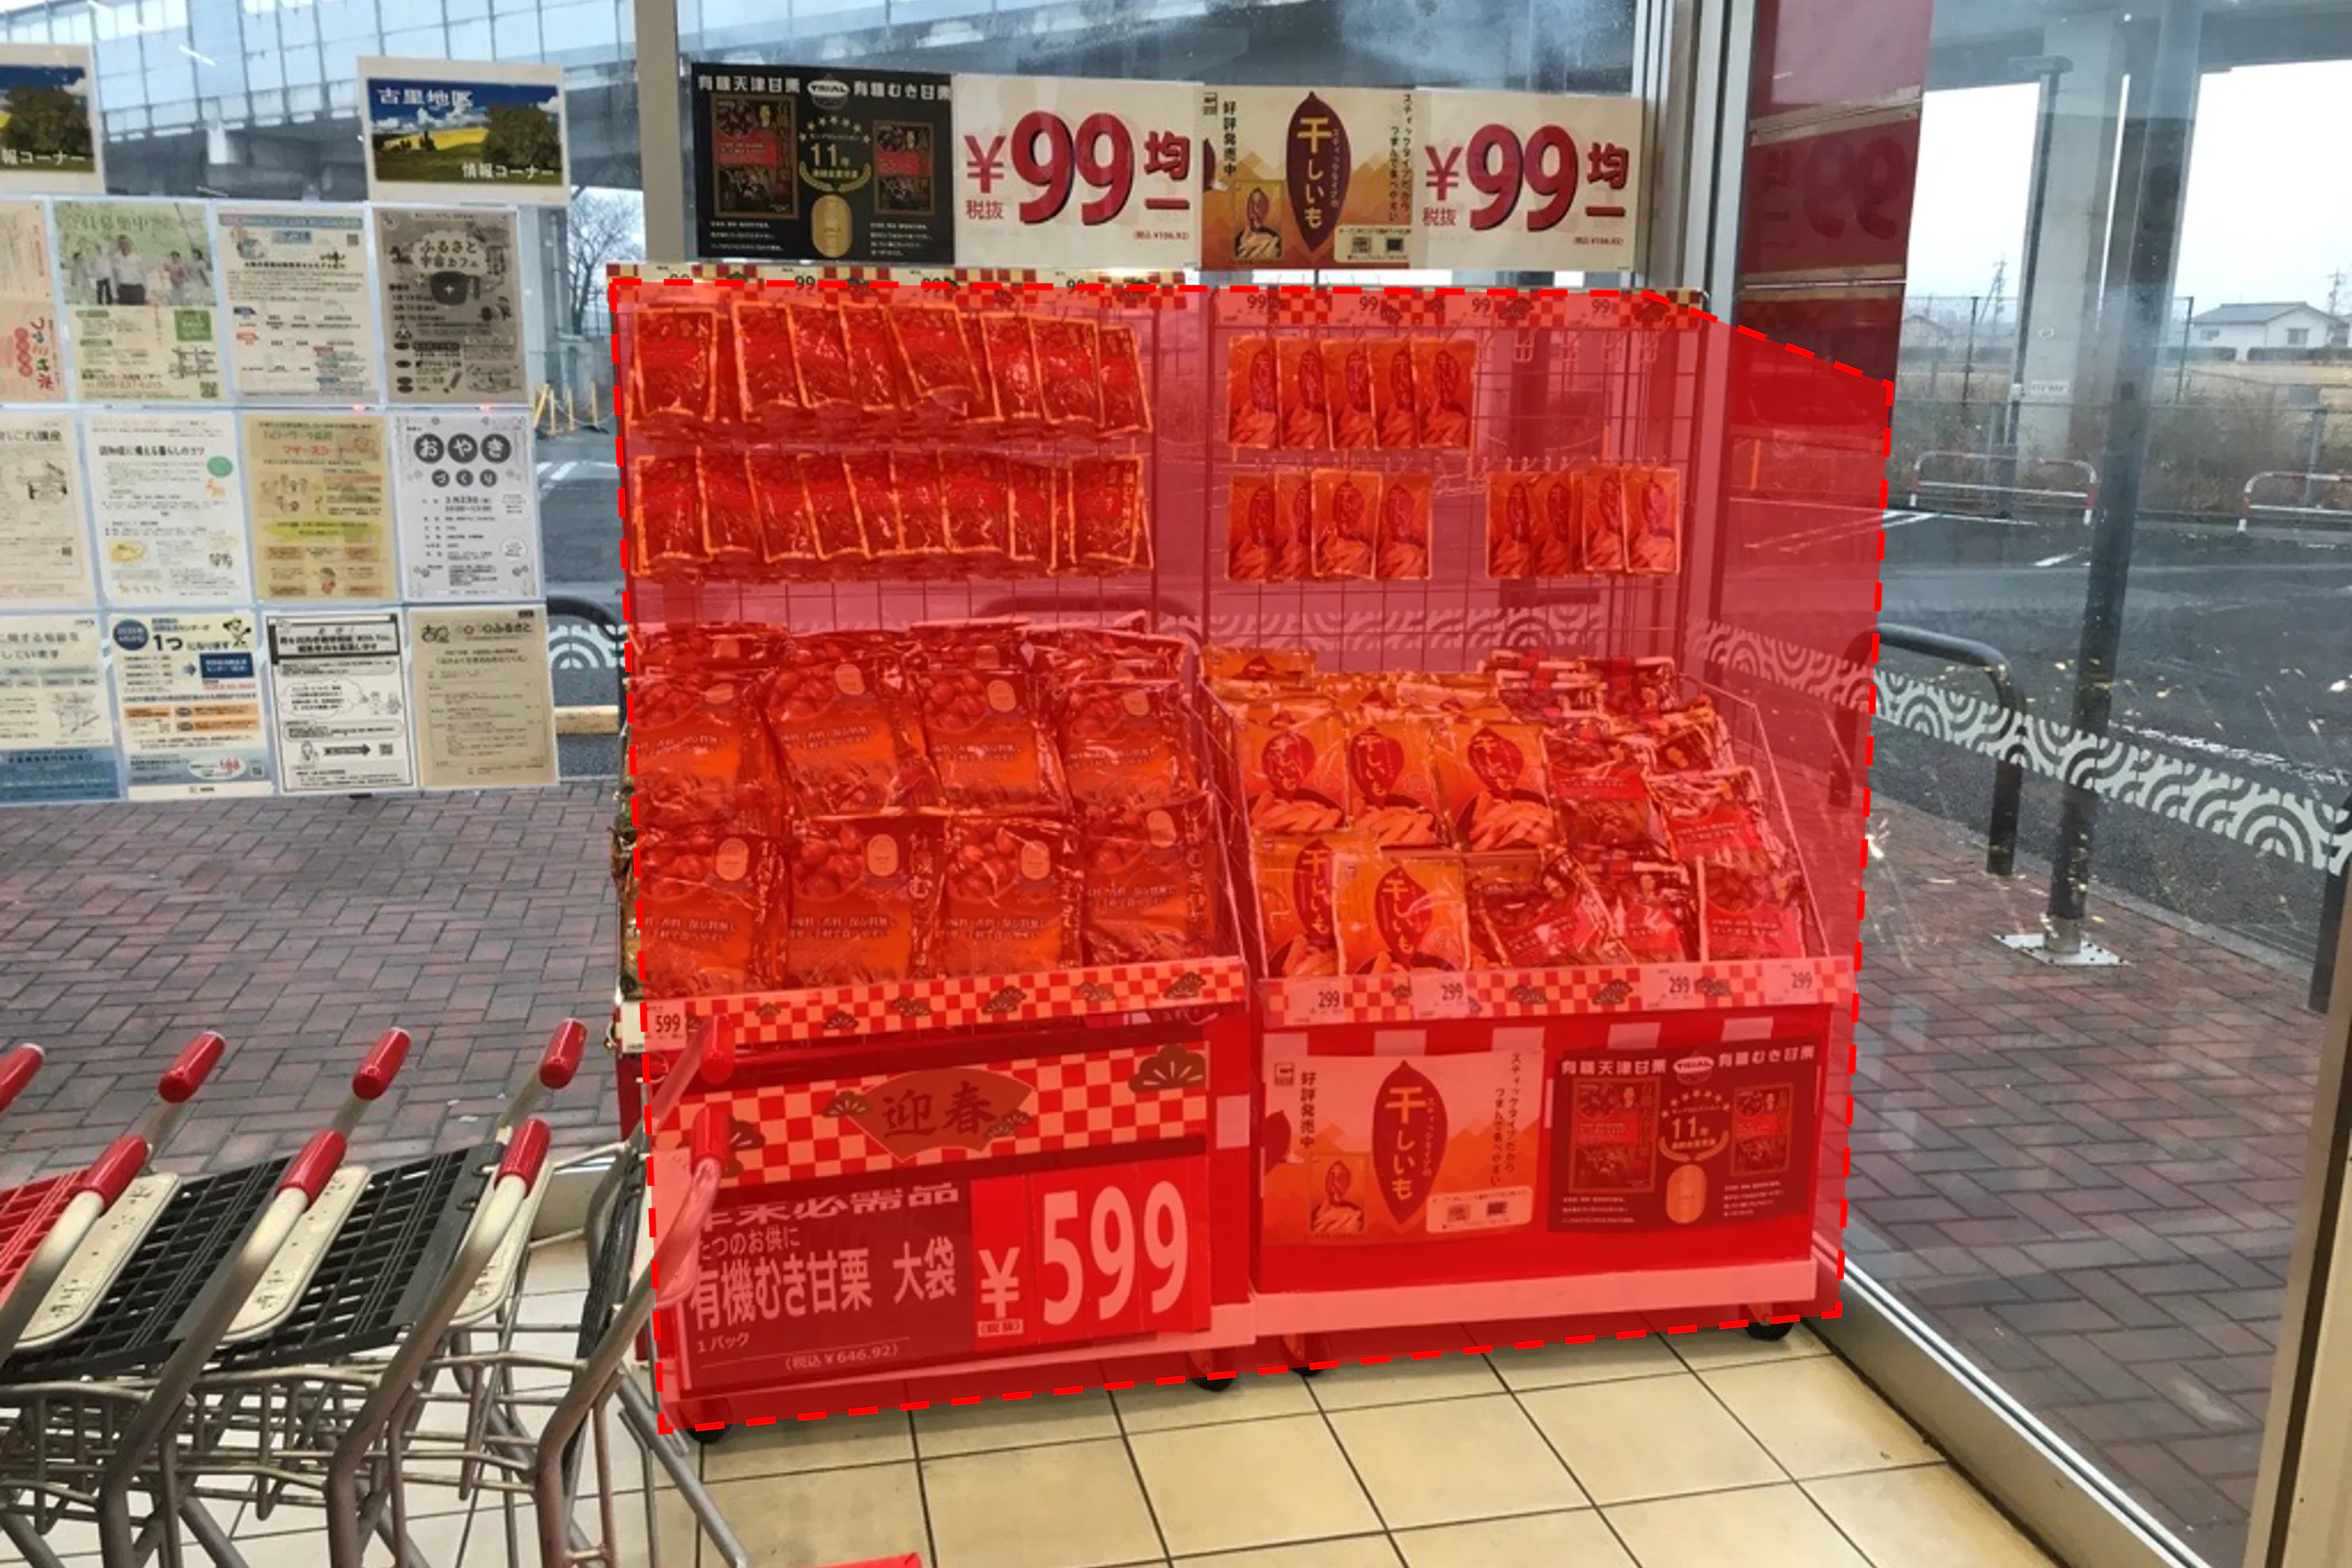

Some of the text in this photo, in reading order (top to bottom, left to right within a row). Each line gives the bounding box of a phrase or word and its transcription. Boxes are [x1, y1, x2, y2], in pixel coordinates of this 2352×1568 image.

[377, 87, 473, 108] 古里地区
[1222, 100, 1237, 176] 好評発売中
[462, 163, 555, 180] 情報コーナー
[1144, 130, 1190, 210] 均一
[1297, 117, 1333, 229] 干しいも
[1585, 143, 1629, 217] 均一
[966, 200, 1004, 220] 税抜
[1423, 207, 1456, 226] 税抜
[420, 239, 477, 254] ふるさと
[1247, 294, 1267, 309] 99
[1359, 296, 1378, 311] 99
[1472, 296, 1491, 313] 99
[1592, 299, 1611, 314] 99
[418, 437, 506, 460] おやき
[1669, 976, 1690, 994] 299
[1791, 971, 1812, 989] 299
[1318, 990, 1340, 1007] 299
[1441, 983, 1463, 1001] 299
[656, 1013, 680, 1033] 599
[882, 1080, 996, 1139] 迎春
[1300, 1071, 1317, 1149] 好評発売中
[1384, 1086, 1428, 1202] 干しいも
[690, 1234, 956, 1331] 有機むき甘栗 大袋
